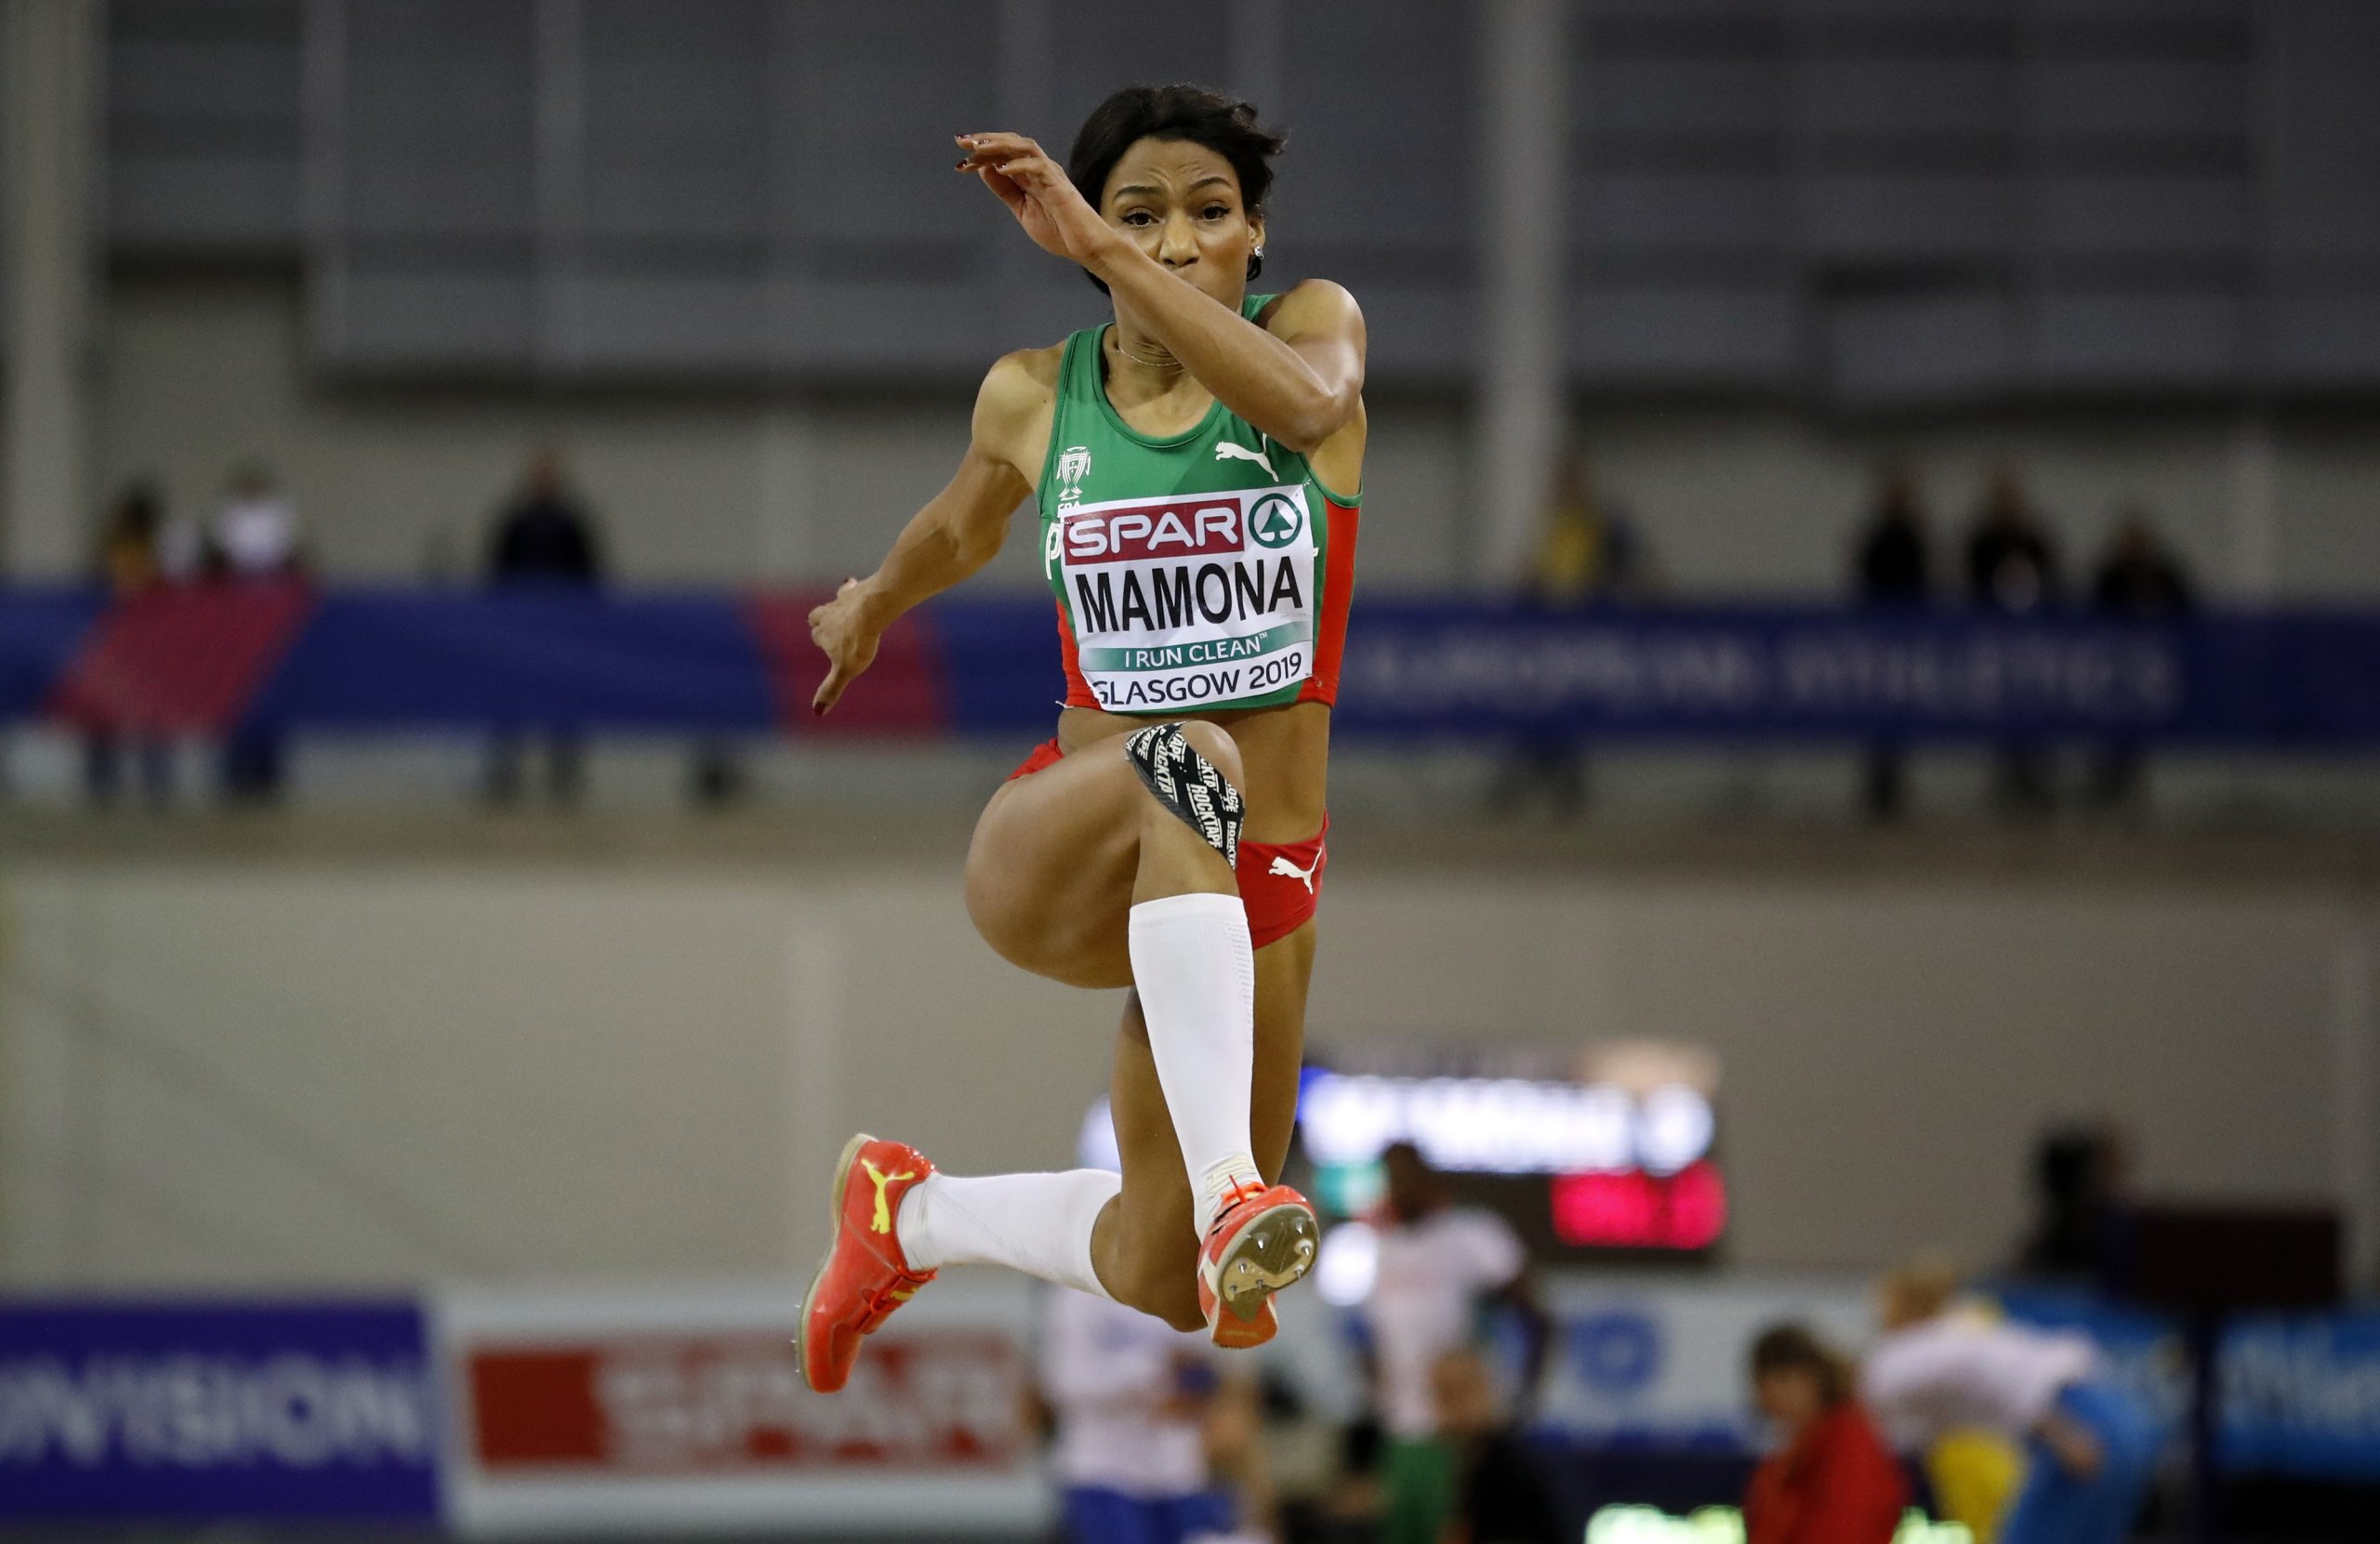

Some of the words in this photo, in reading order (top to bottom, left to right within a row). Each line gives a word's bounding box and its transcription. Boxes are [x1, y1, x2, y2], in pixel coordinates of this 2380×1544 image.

[1068, 506, 1239, 557] SPAR
[1075, 556, 1302, 633] MAMONA
[1091, 669, 1240, 706] GLASGOW
[1249, 653, 1302, 690] 2019
[1125, 651, 1130, 667] I
[1135, 647, 1183, 667] RUN
